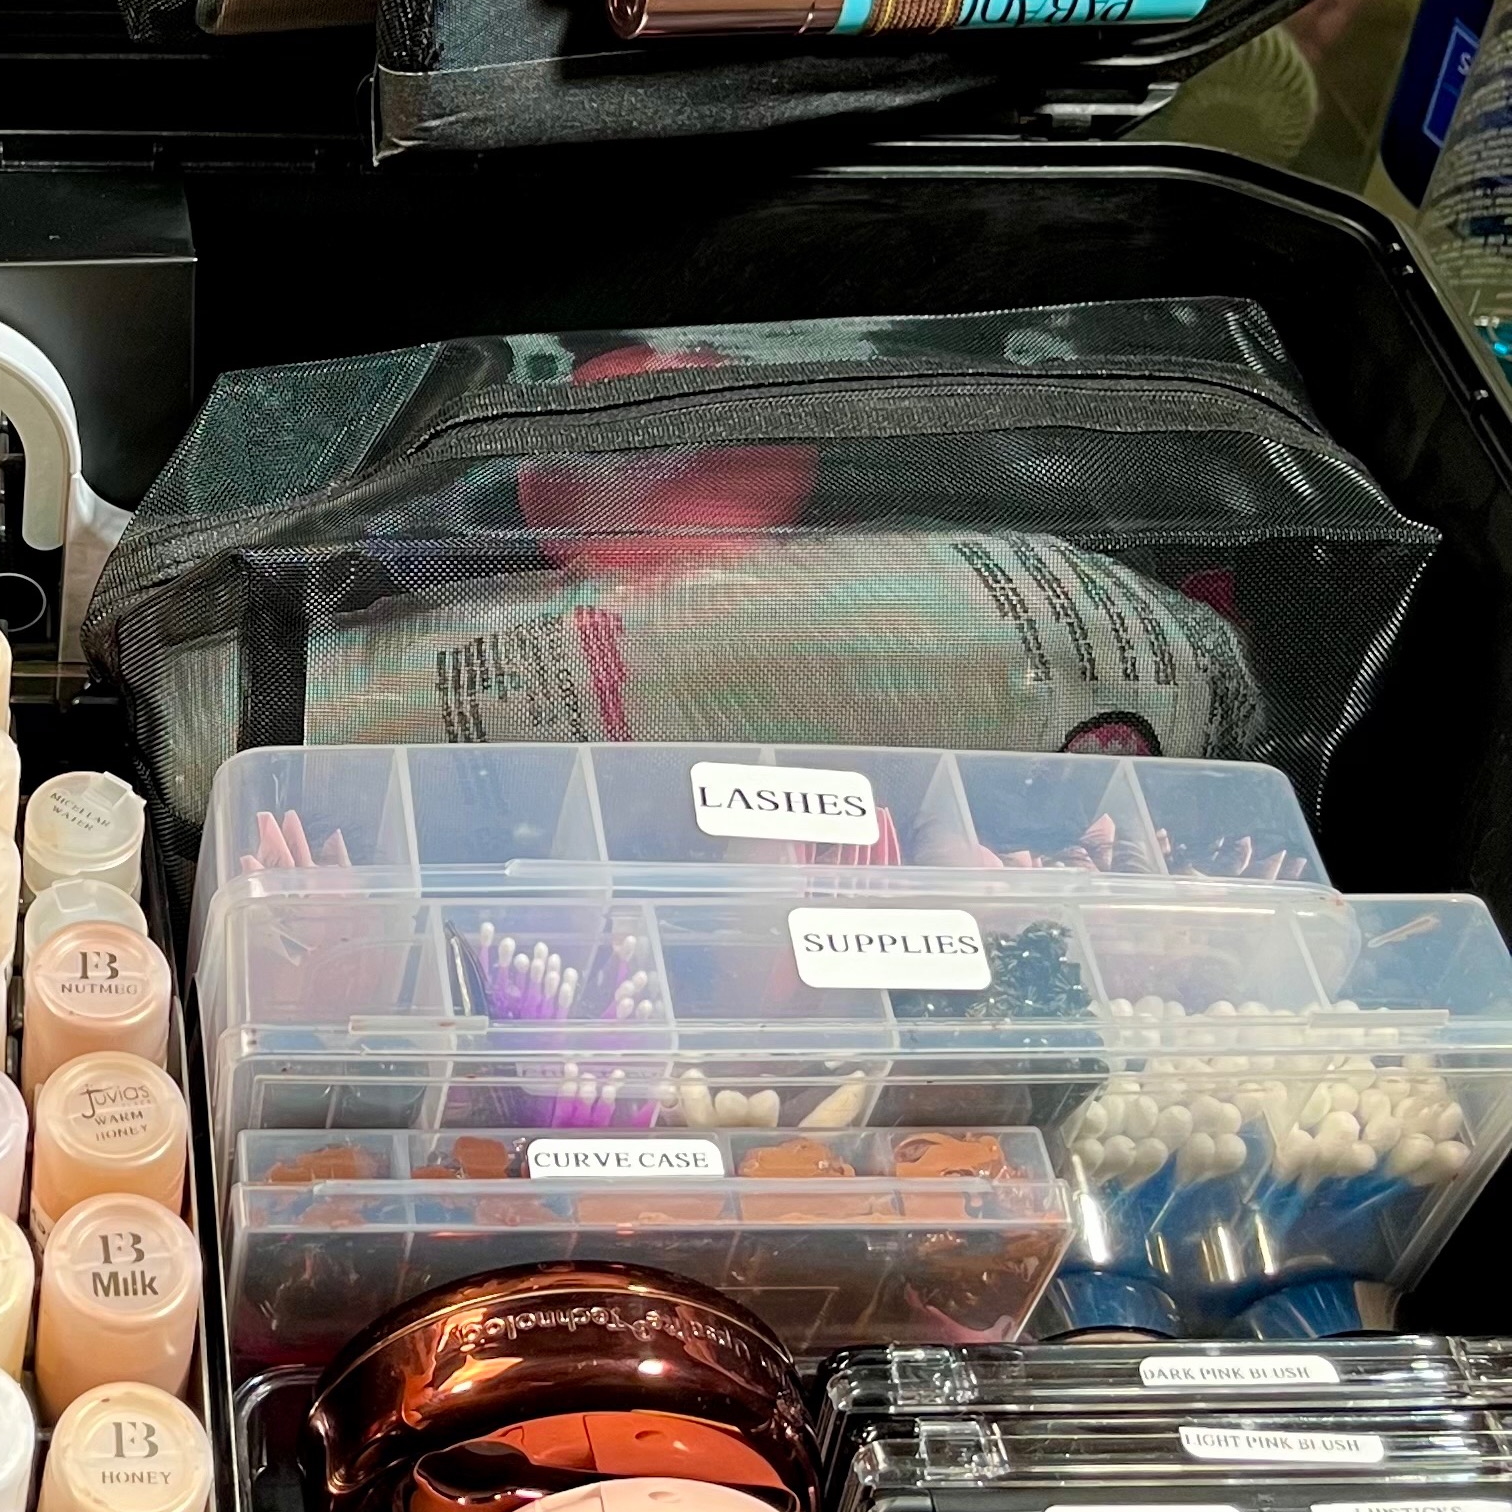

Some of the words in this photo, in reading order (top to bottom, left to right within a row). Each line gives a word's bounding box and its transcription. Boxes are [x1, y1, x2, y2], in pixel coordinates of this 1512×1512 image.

[50, 791, 111, 828] MICELLAR
[698, 786, 868, 818] LASHES
[51, 805, 94, 831] WATER
[803, 933, 980, 955] SUPPLIES
[61, 983, 138, 995] NUTMEG
[94, 1110, 145, 1126] WARM
[96, 1124, 148, 1141] HONEY
[533, 1151, 632, 1169] CURVE
[638, 1151, 710, 1169] CASE
[91, 1270, 159, 1299] Milk
[1143, 1367, 1195, 1381] DARK
[1201, 1366, 1246, 1381] PINK
[1250, 1365, 1311, 1380] BLUSH
[1184, 1433, 1242, 1449] LIGHT
[1247, 1435, 1293, 1450] PINK
[1298, 1437, 1360, 1453] BLUSH
[101, 1471, 172, 1485] HONEY
